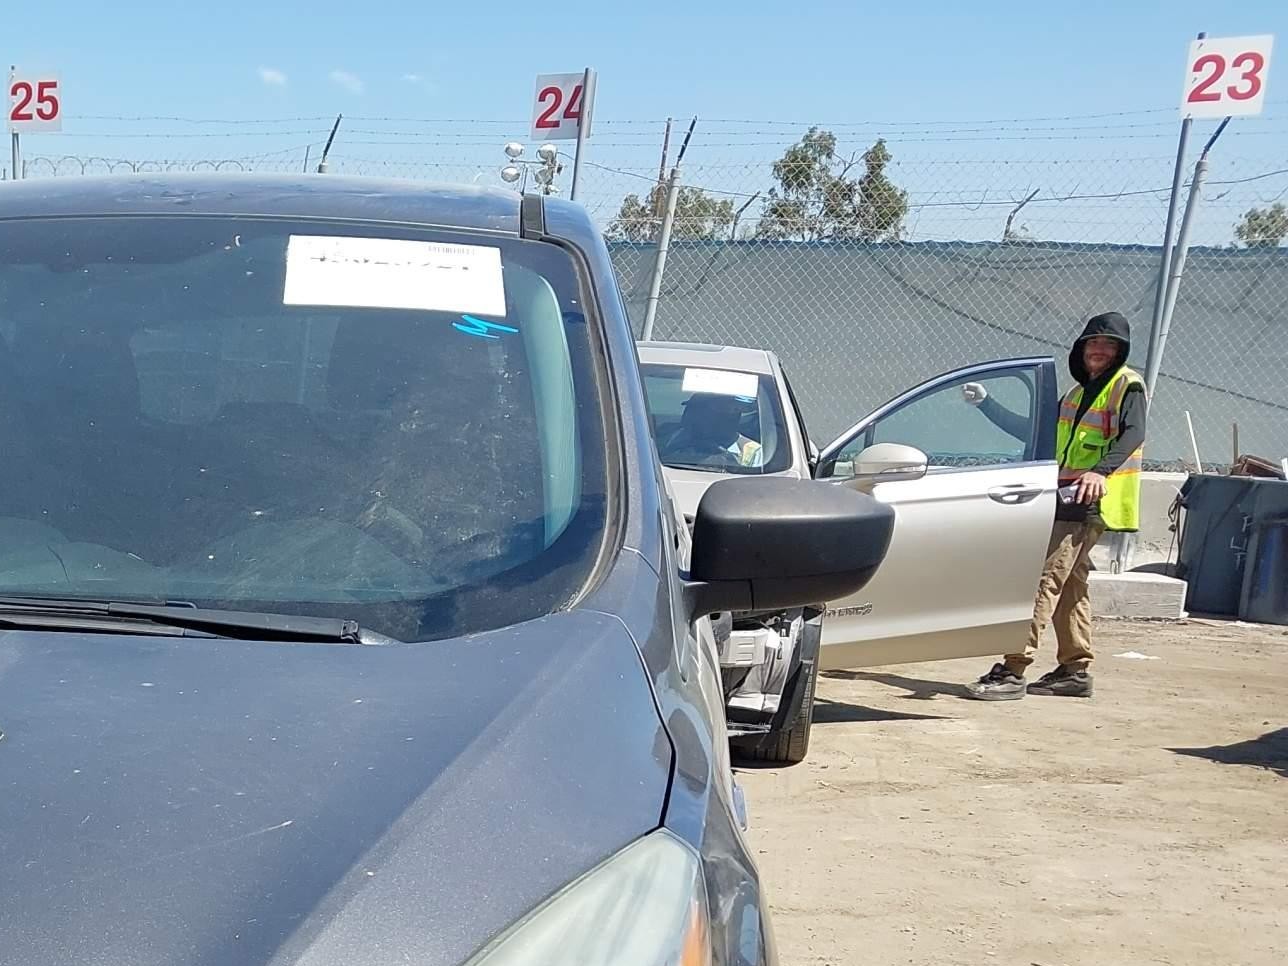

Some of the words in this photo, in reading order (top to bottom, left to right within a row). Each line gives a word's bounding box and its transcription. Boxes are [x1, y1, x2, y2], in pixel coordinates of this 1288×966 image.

[1187, 52, 1265, 103] 23
[10, 81, 59, 121] 25
[535, 85, 584, 129] 24
